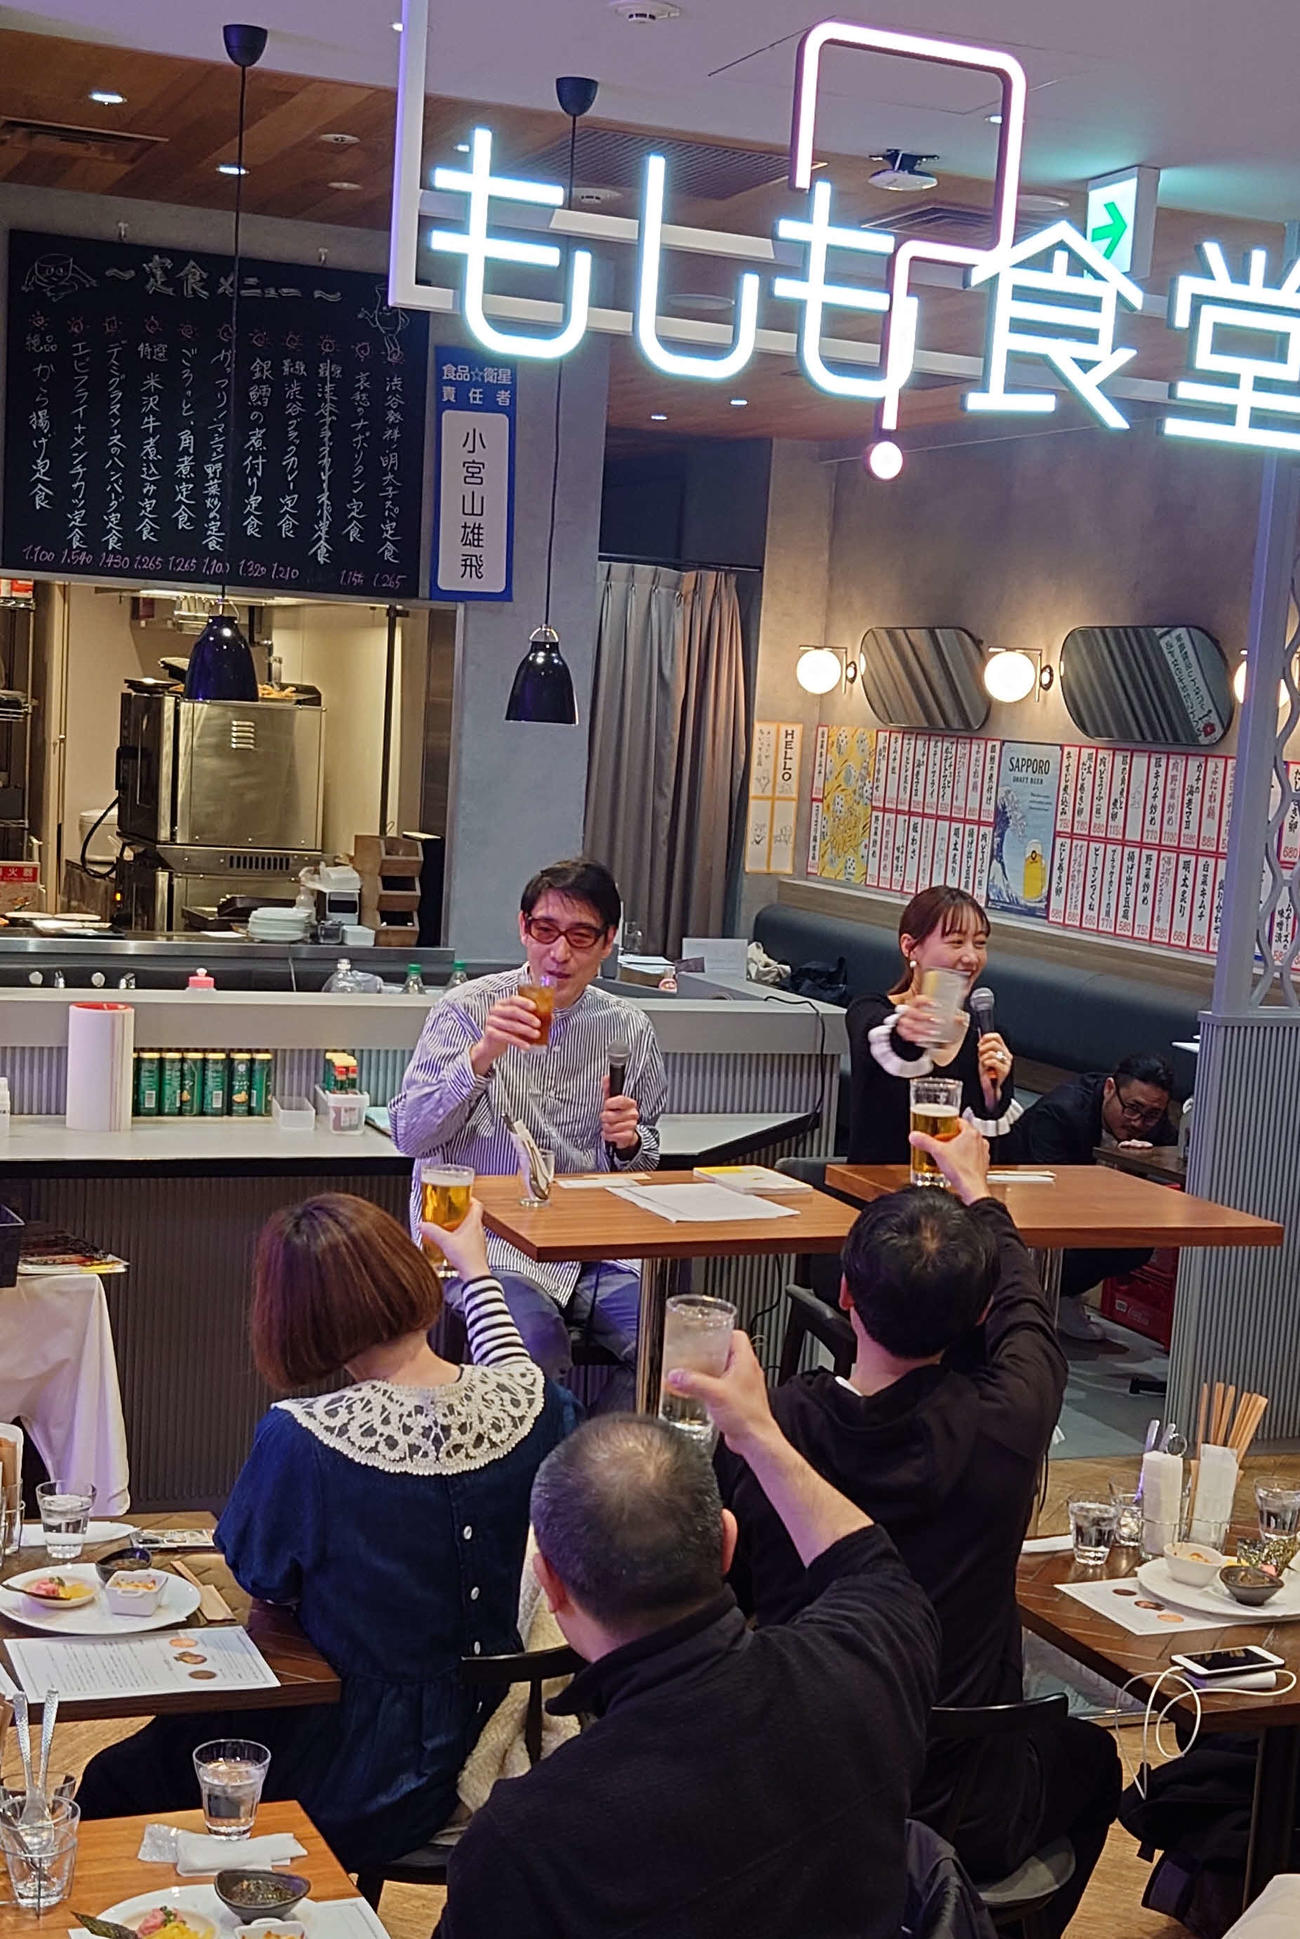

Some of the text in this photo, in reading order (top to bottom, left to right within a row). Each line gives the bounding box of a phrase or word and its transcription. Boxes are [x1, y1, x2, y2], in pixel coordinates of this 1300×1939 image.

[427, 128, 1300, 450] もしも食堂
[28, 362, 56, 510] から揚げ定食
[135, 372, 165, 543] 米沢牛煮込み定食
[277, 378, 306, 539] 渋谷ブラックカレー定食
[342, 371, 372, 543] 哀愁のナポリタン定食
[460, 427, 488, 580] 小宮山雄飛
[782, 729, 796, 783] HELLO
[1008, 755, 1051, 776] SAPPORO
[1030, 777, 1044, 785] BEER
[1148, 756, 1163, 827] 豚キムチ炒め
[1086, 846, 1101, 912] ピーマンつくね
[1119, 850, 1136, 921] 揚げ出し豆腐
[1140, 852, 1154, 906] 野菜炒め
[1197, 860, 1210, 920] 白菜キムチ
[1192, 934, 1206, 946] 330
